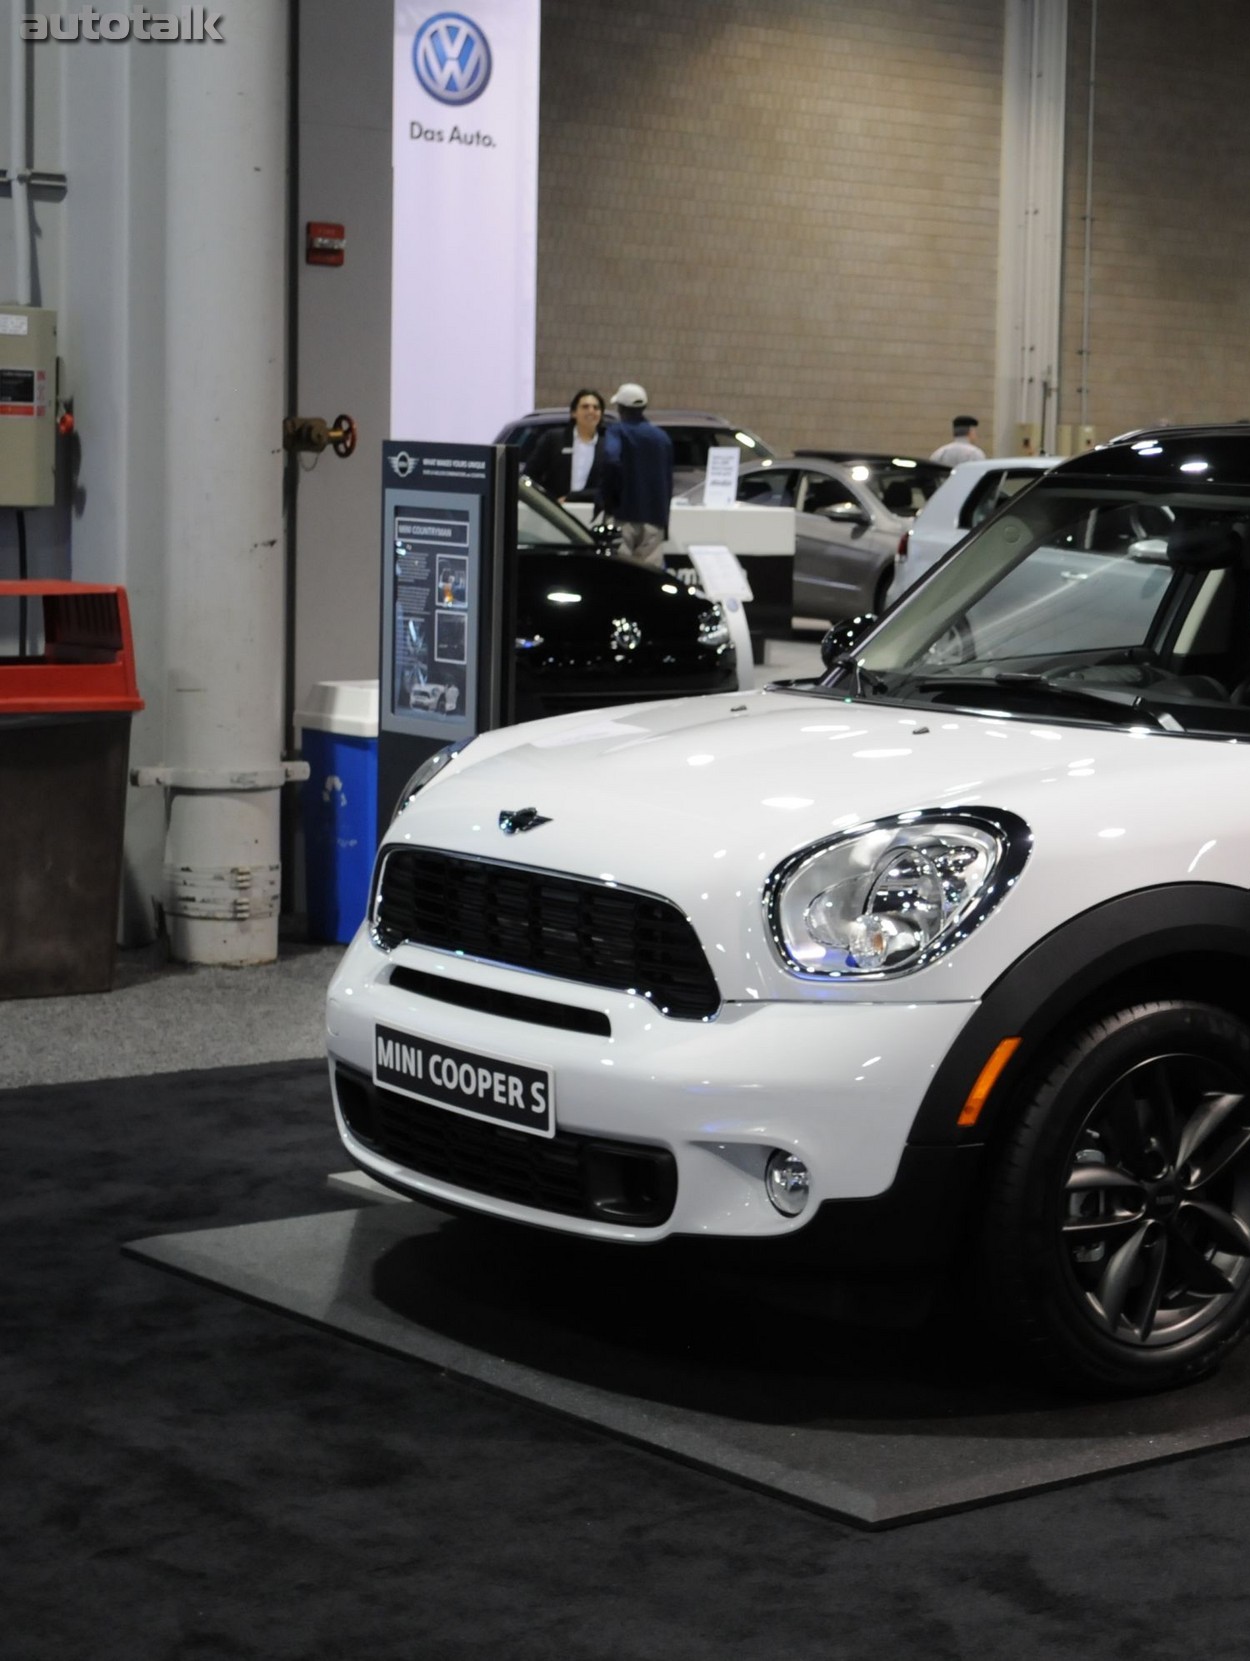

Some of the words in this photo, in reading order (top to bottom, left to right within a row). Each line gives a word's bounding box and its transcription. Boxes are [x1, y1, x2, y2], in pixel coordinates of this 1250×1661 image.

[410, 121, 444, 142] Das
[449, 125, 496, 148] Auto.
[377, 1036, 423, 1079] MINI
[428, 1054, 525, 1109] COOPER
[530, 1081, 546, 1114] S
